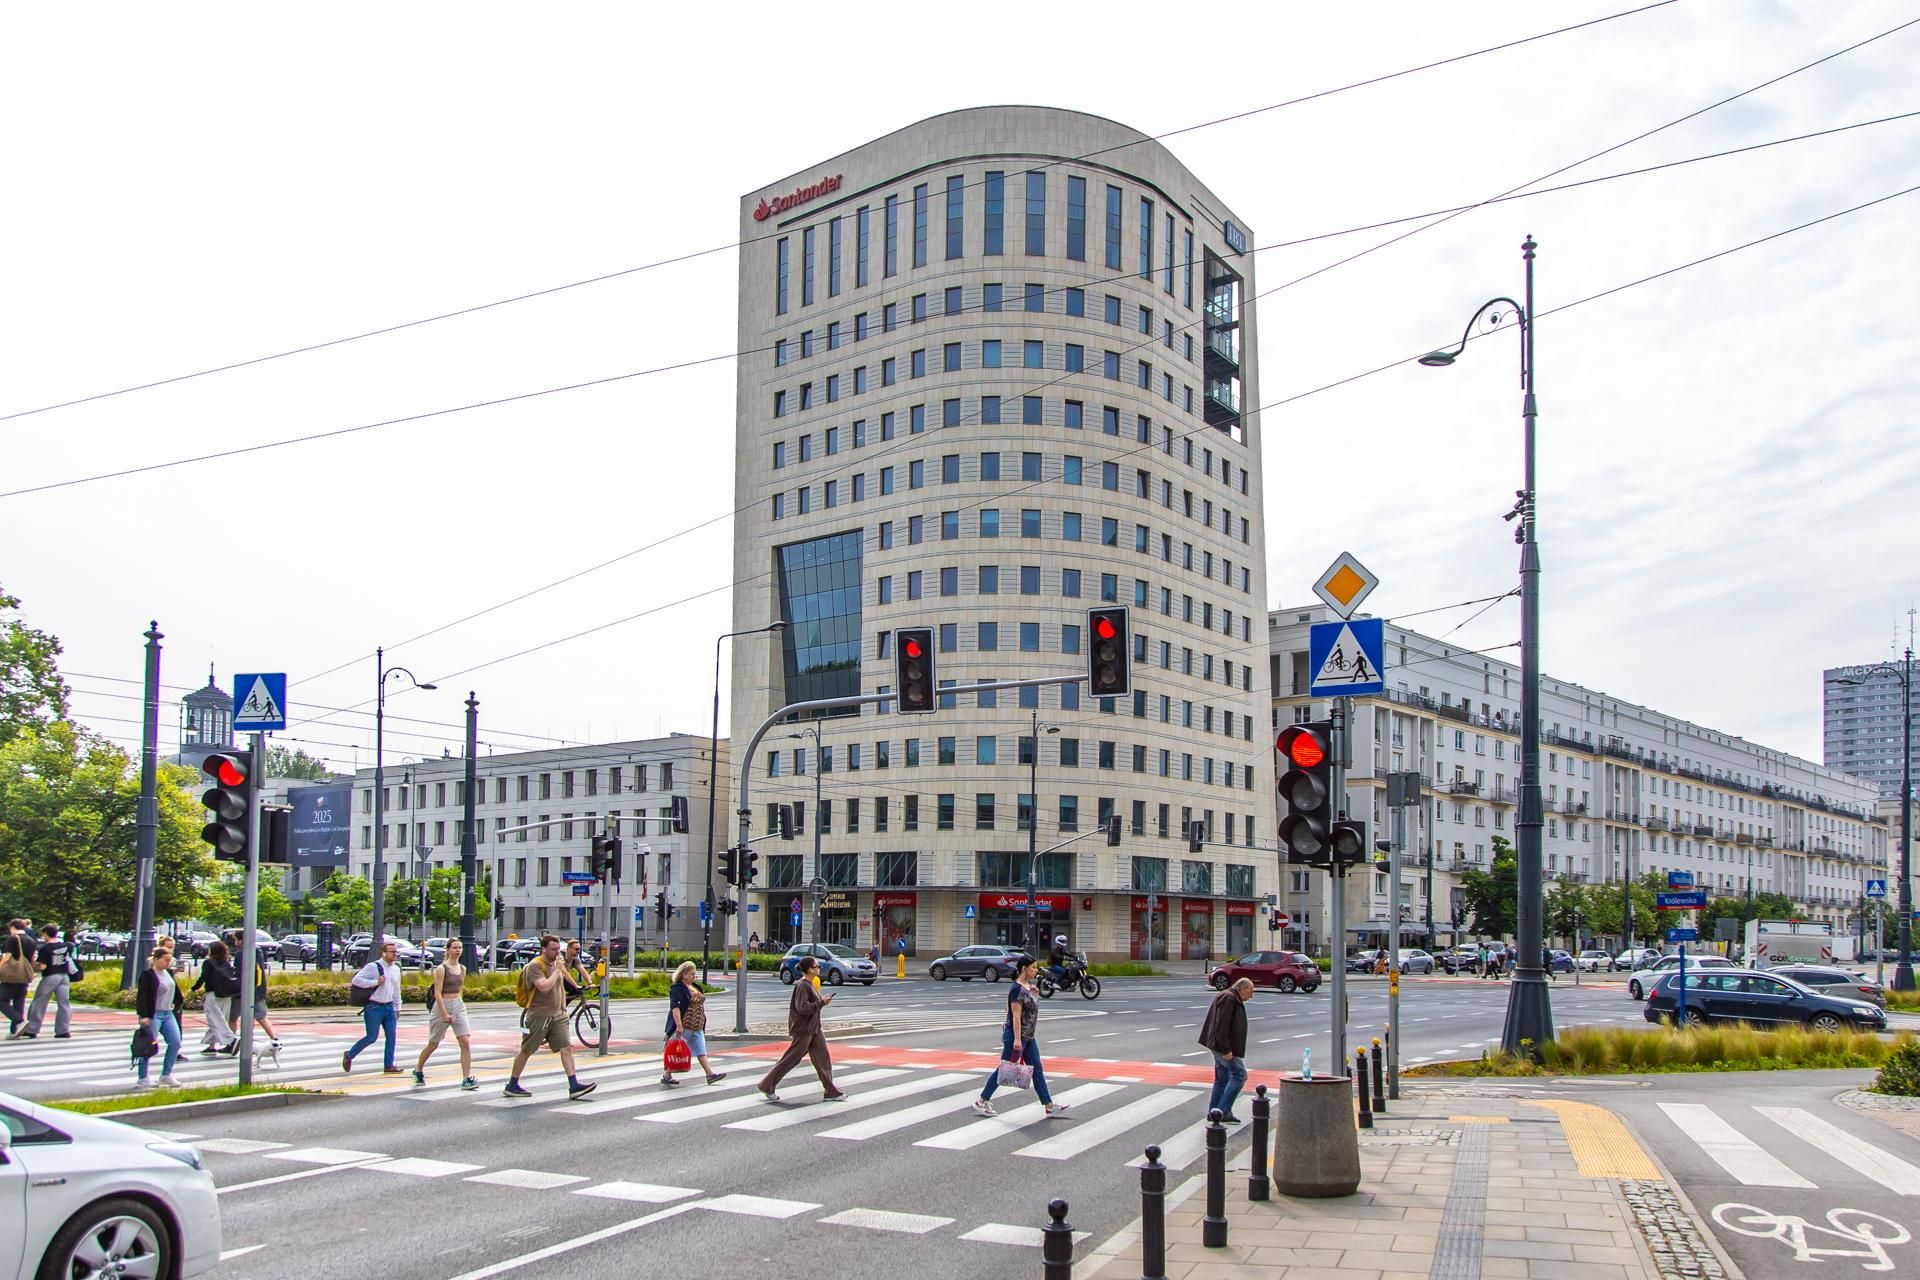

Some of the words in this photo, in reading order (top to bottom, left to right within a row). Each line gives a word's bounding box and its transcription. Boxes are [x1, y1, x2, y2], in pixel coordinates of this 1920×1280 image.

[771, 174, 843, 215] Santander
[313, 810, 332, 824] 2025
[1008, 898, 1052, 906] Santnder
